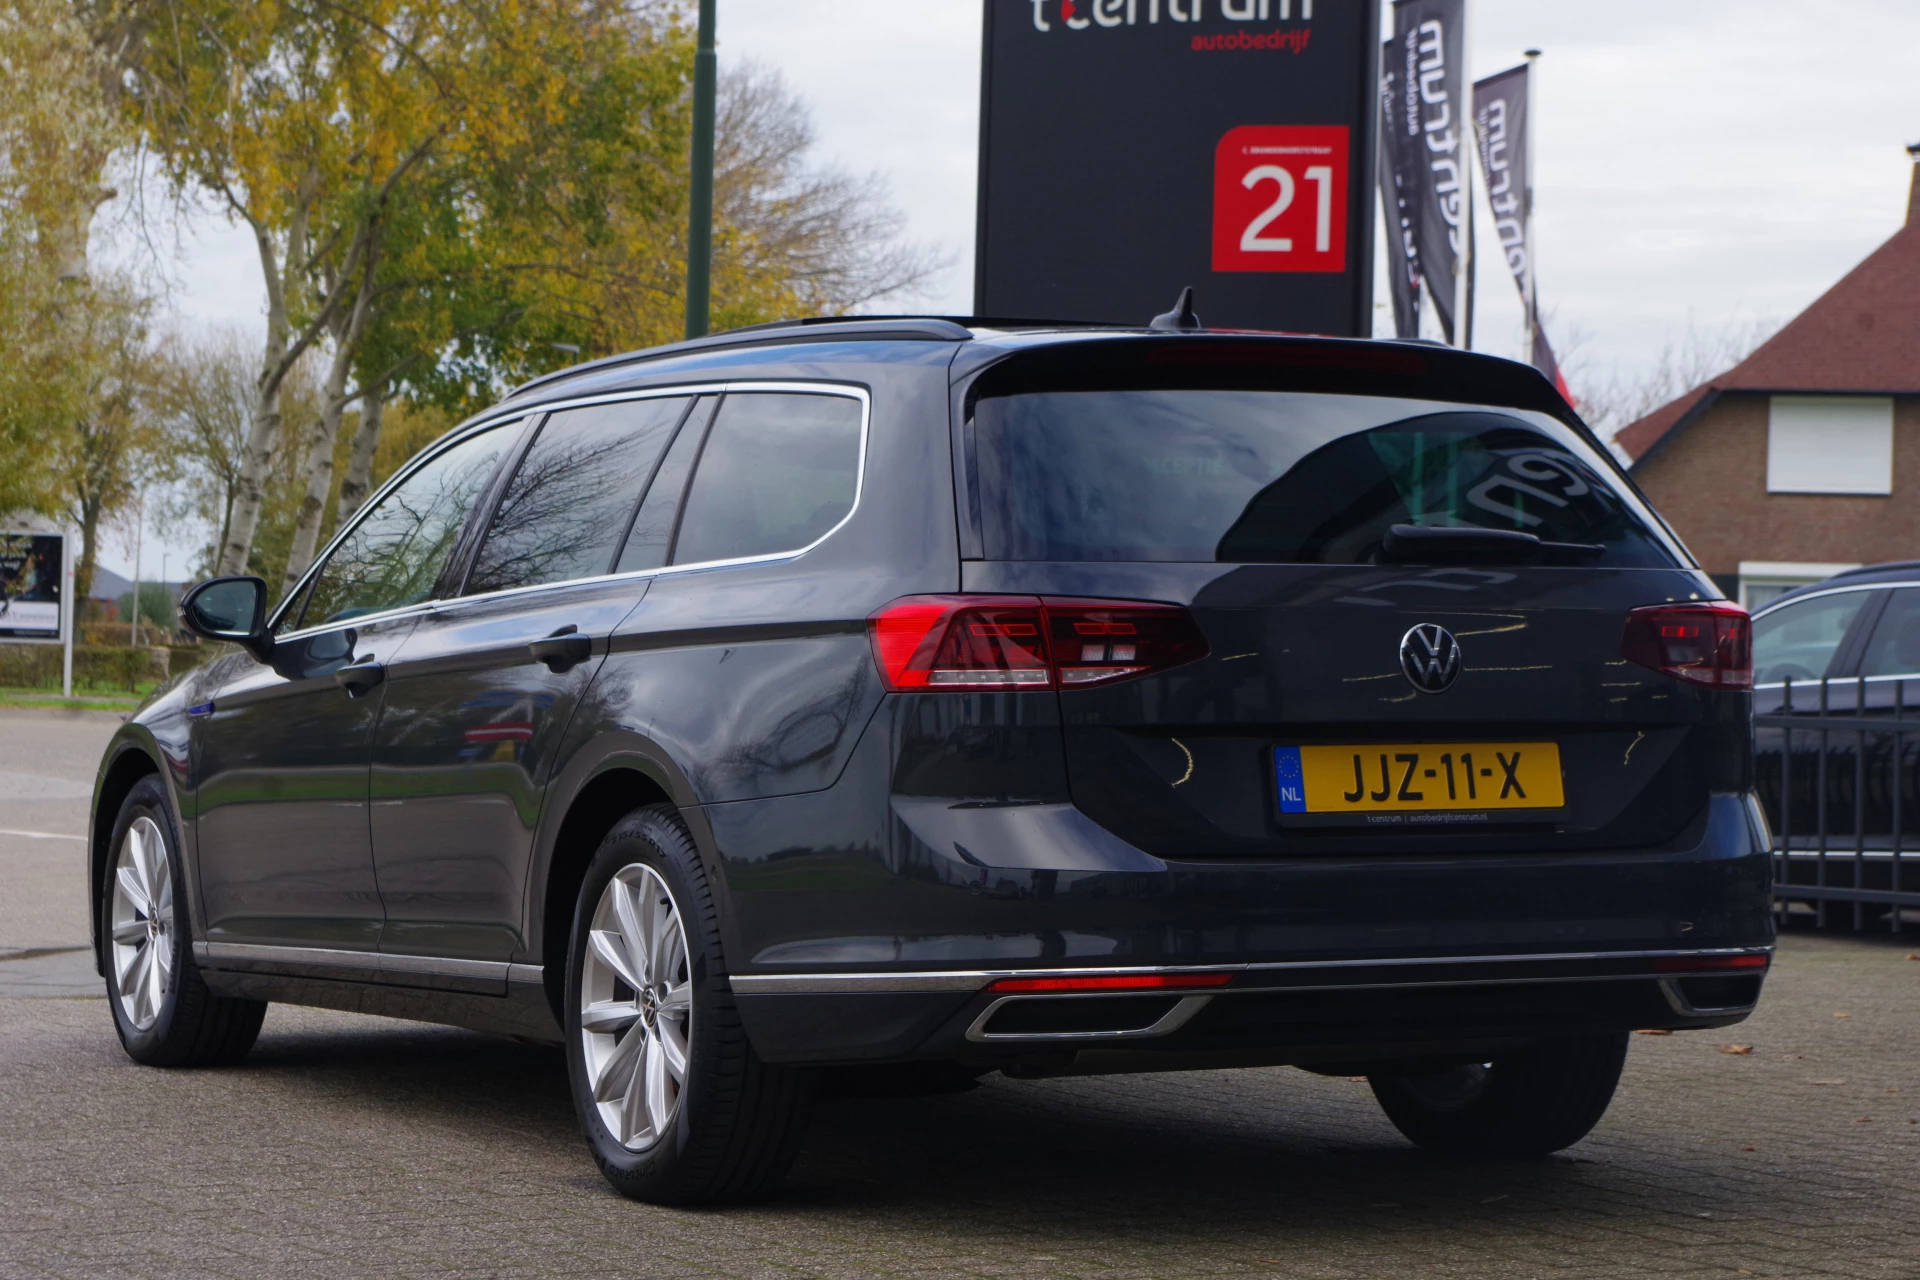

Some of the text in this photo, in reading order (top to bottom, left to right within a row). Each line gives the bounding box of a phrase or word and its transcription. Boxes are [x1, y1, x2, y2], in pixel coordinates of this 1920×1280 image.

[1191, 29, 1311, 54] autobedrijf
[1240, 164, 1332, 252] 21
[1281, 787, 1302, 801] NL
[1343, 752, 1527, 803] JJZ-11-X
